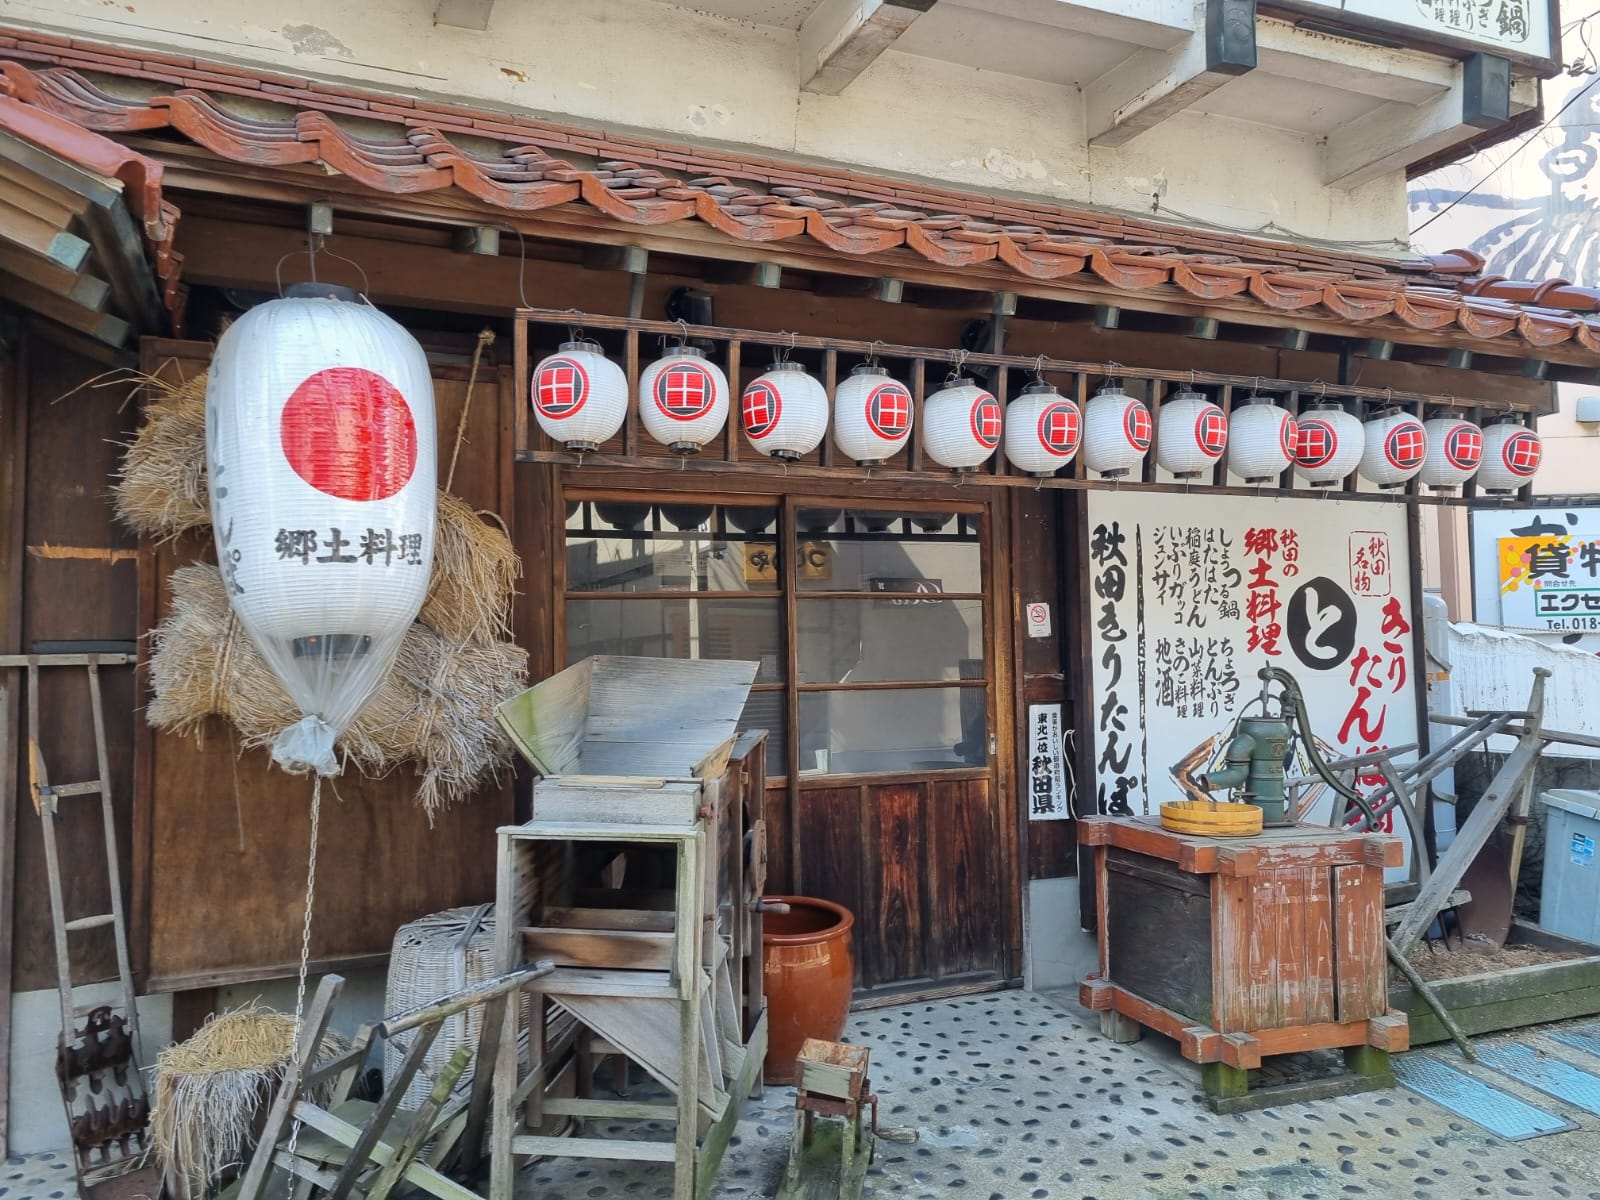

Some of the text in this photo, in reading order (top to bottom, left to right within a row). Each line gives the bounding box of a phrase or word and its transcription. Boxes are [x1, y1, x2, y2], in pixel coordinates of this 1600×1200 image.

[1496, 0, 1527, 40] 鍋
[274, 527, 423, 566] 郷土料理
[1152, 527, 1171, 606] ジュンサイ
[1166, 526, 1187, 625] いぶりガッコ
[1185, 527, 1206, 628] 稲庭うどん
[1203, 528, 1220, 606] はたはた
[1217, 527, 1242, 621] しょっつる鍋
[1280, 529, 1299, 577] 秋田の
[1354, 547, 1371, 592] 名物
[1369, 537, 1385, 576] 秋田
[1244, 528, 1282, 656] 郷土料理
[1304, 587, 1343, 660] と
[1091, 522, 1138, 816] 秋田きりたんぽ
[1154, 637, 1175, 707] 地酒
[1173, 637, 1190, 719] きのこ料理
[1189, 637, 1206, 719] 山菜料理
[1206, 637, 1223, 719] とんぶり
[1221, 637, 1241, 713] ちょろぎ
[1380, 596, 1411, 694] きり
[1037, 713, 1049, 752] 東北一位
[1032, 756, 1056, 815] 秋田県
